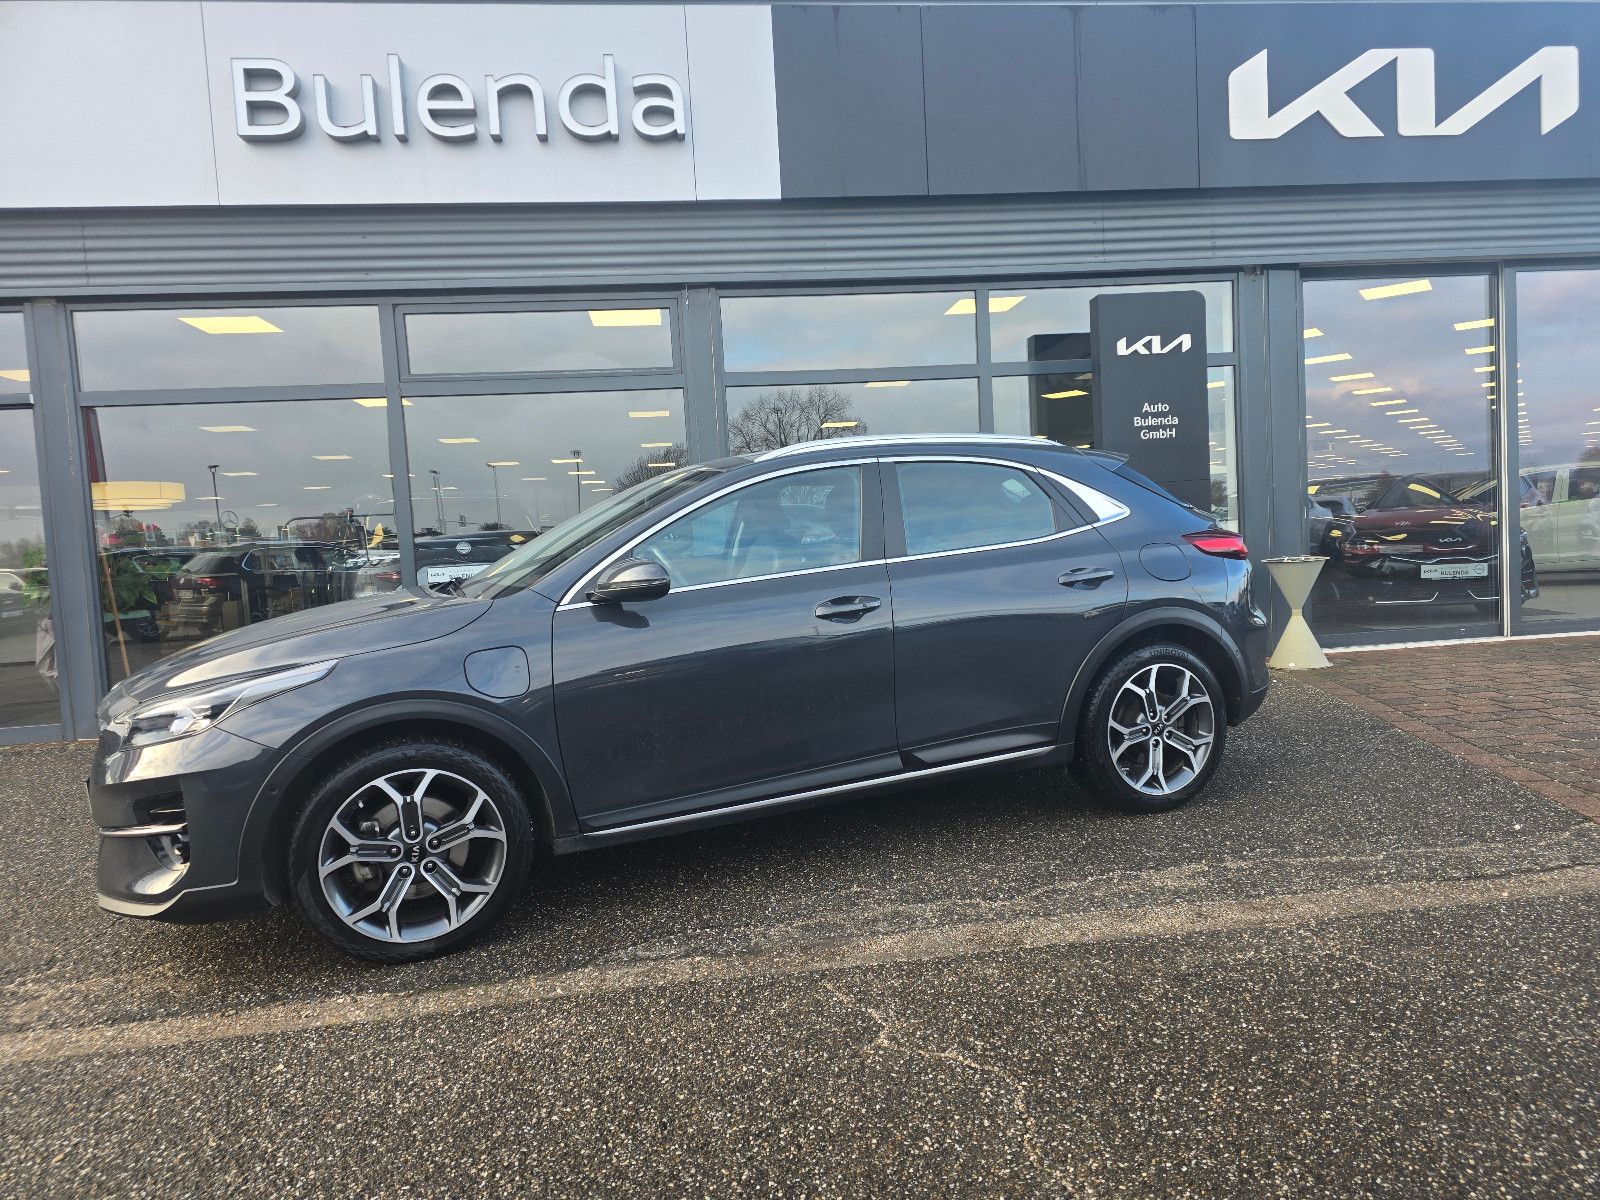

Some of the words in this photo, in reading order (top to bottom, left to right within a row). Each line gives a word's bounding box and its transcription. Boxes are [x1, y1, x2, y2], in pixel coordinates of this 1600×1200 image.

[230, 53, 687, 142] Bulenda
[1228, 46, 1580, 140] KIA
[1116, 333, 1192, 356] KIA
[1142, 402, 1170, 413] Auto
[1133, 414, 1179, 427] Bulenda
[1140, 428, 1176, 440] GmbH
[411, 845, 420, 863] KIA
